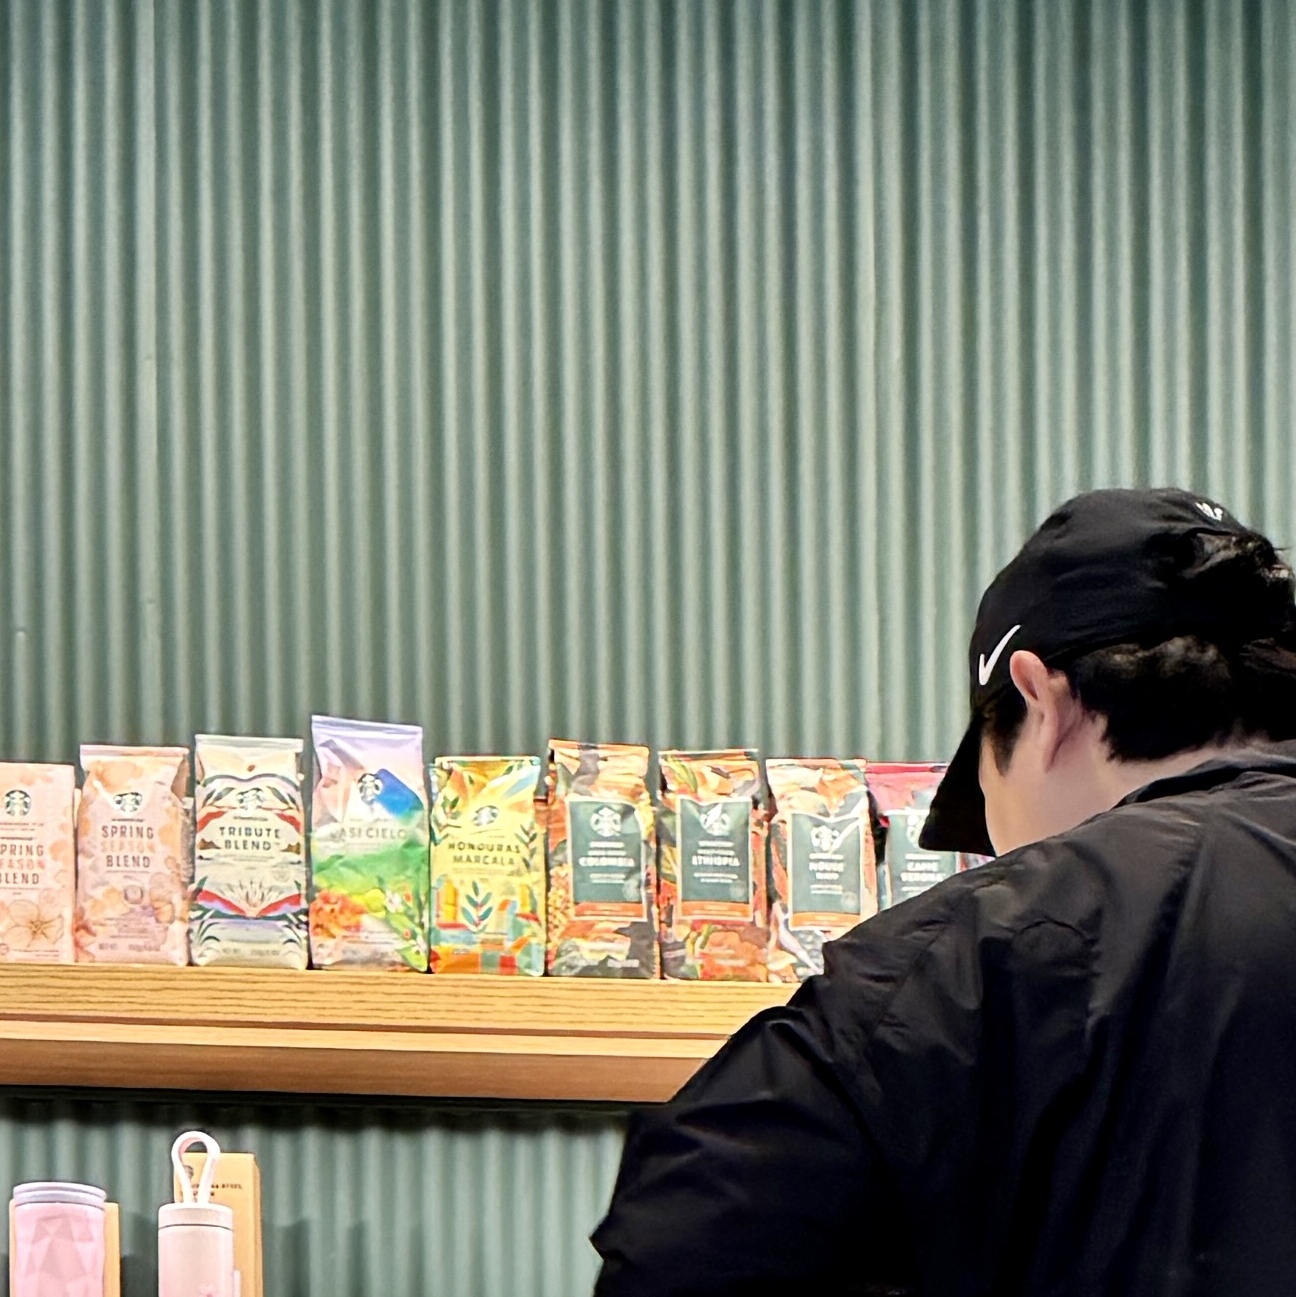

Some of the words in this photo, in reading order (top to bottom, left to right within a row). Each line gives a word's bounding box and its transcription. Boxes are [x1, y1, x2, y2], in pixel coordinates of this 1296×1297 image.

[102, 825, 154, 840] SPRING
[219, 826, 280, 839] TRIBUTE
[366, 827, 407, 840] CIELO
[224, 840, 271, 851] BLEND
[448, 841, 521, 854] HONDURAS
[106, 855, 151, 868] BLEND
[453, 855, 515, 865] MARCALA
